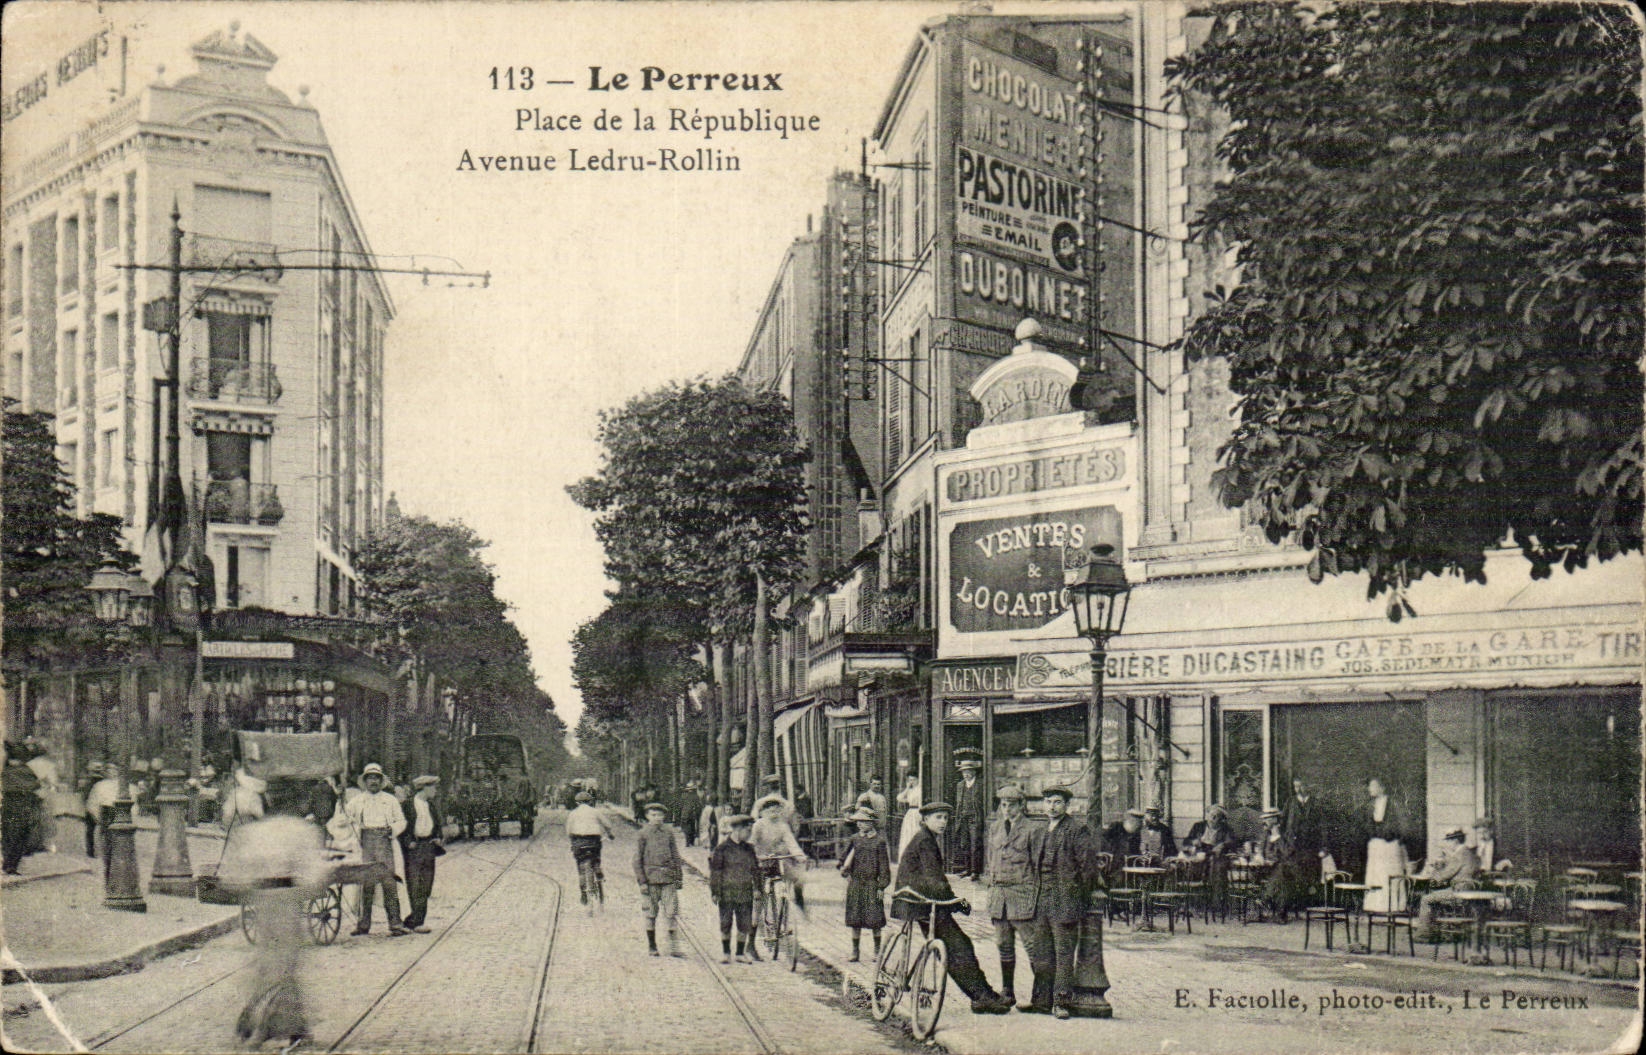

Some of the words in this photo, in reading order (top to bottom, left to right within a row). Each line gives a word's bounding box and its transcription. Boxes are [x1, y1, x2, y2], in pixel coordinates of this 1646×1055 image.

[969, 57, 1076, 127] CHOCOLAT
[958, 149, 1082, 220] PASTORINE
[962, 201, 1012, 226] PEINTURE
[961, 252, 1086, 322] DUBONNET
[976, 522, 1087, 558] VENTES
[1028, 563, 1041, 578] &
[957, 577, 1074, 617] LOCATIO
[1489, 630, 1584, 652] GARE
[942, 666, 1003, 692] AGENCE
[1106, 652, 1170, 678] BIÈRE
[1183, 646, 1325, 677] DUCASTAING
